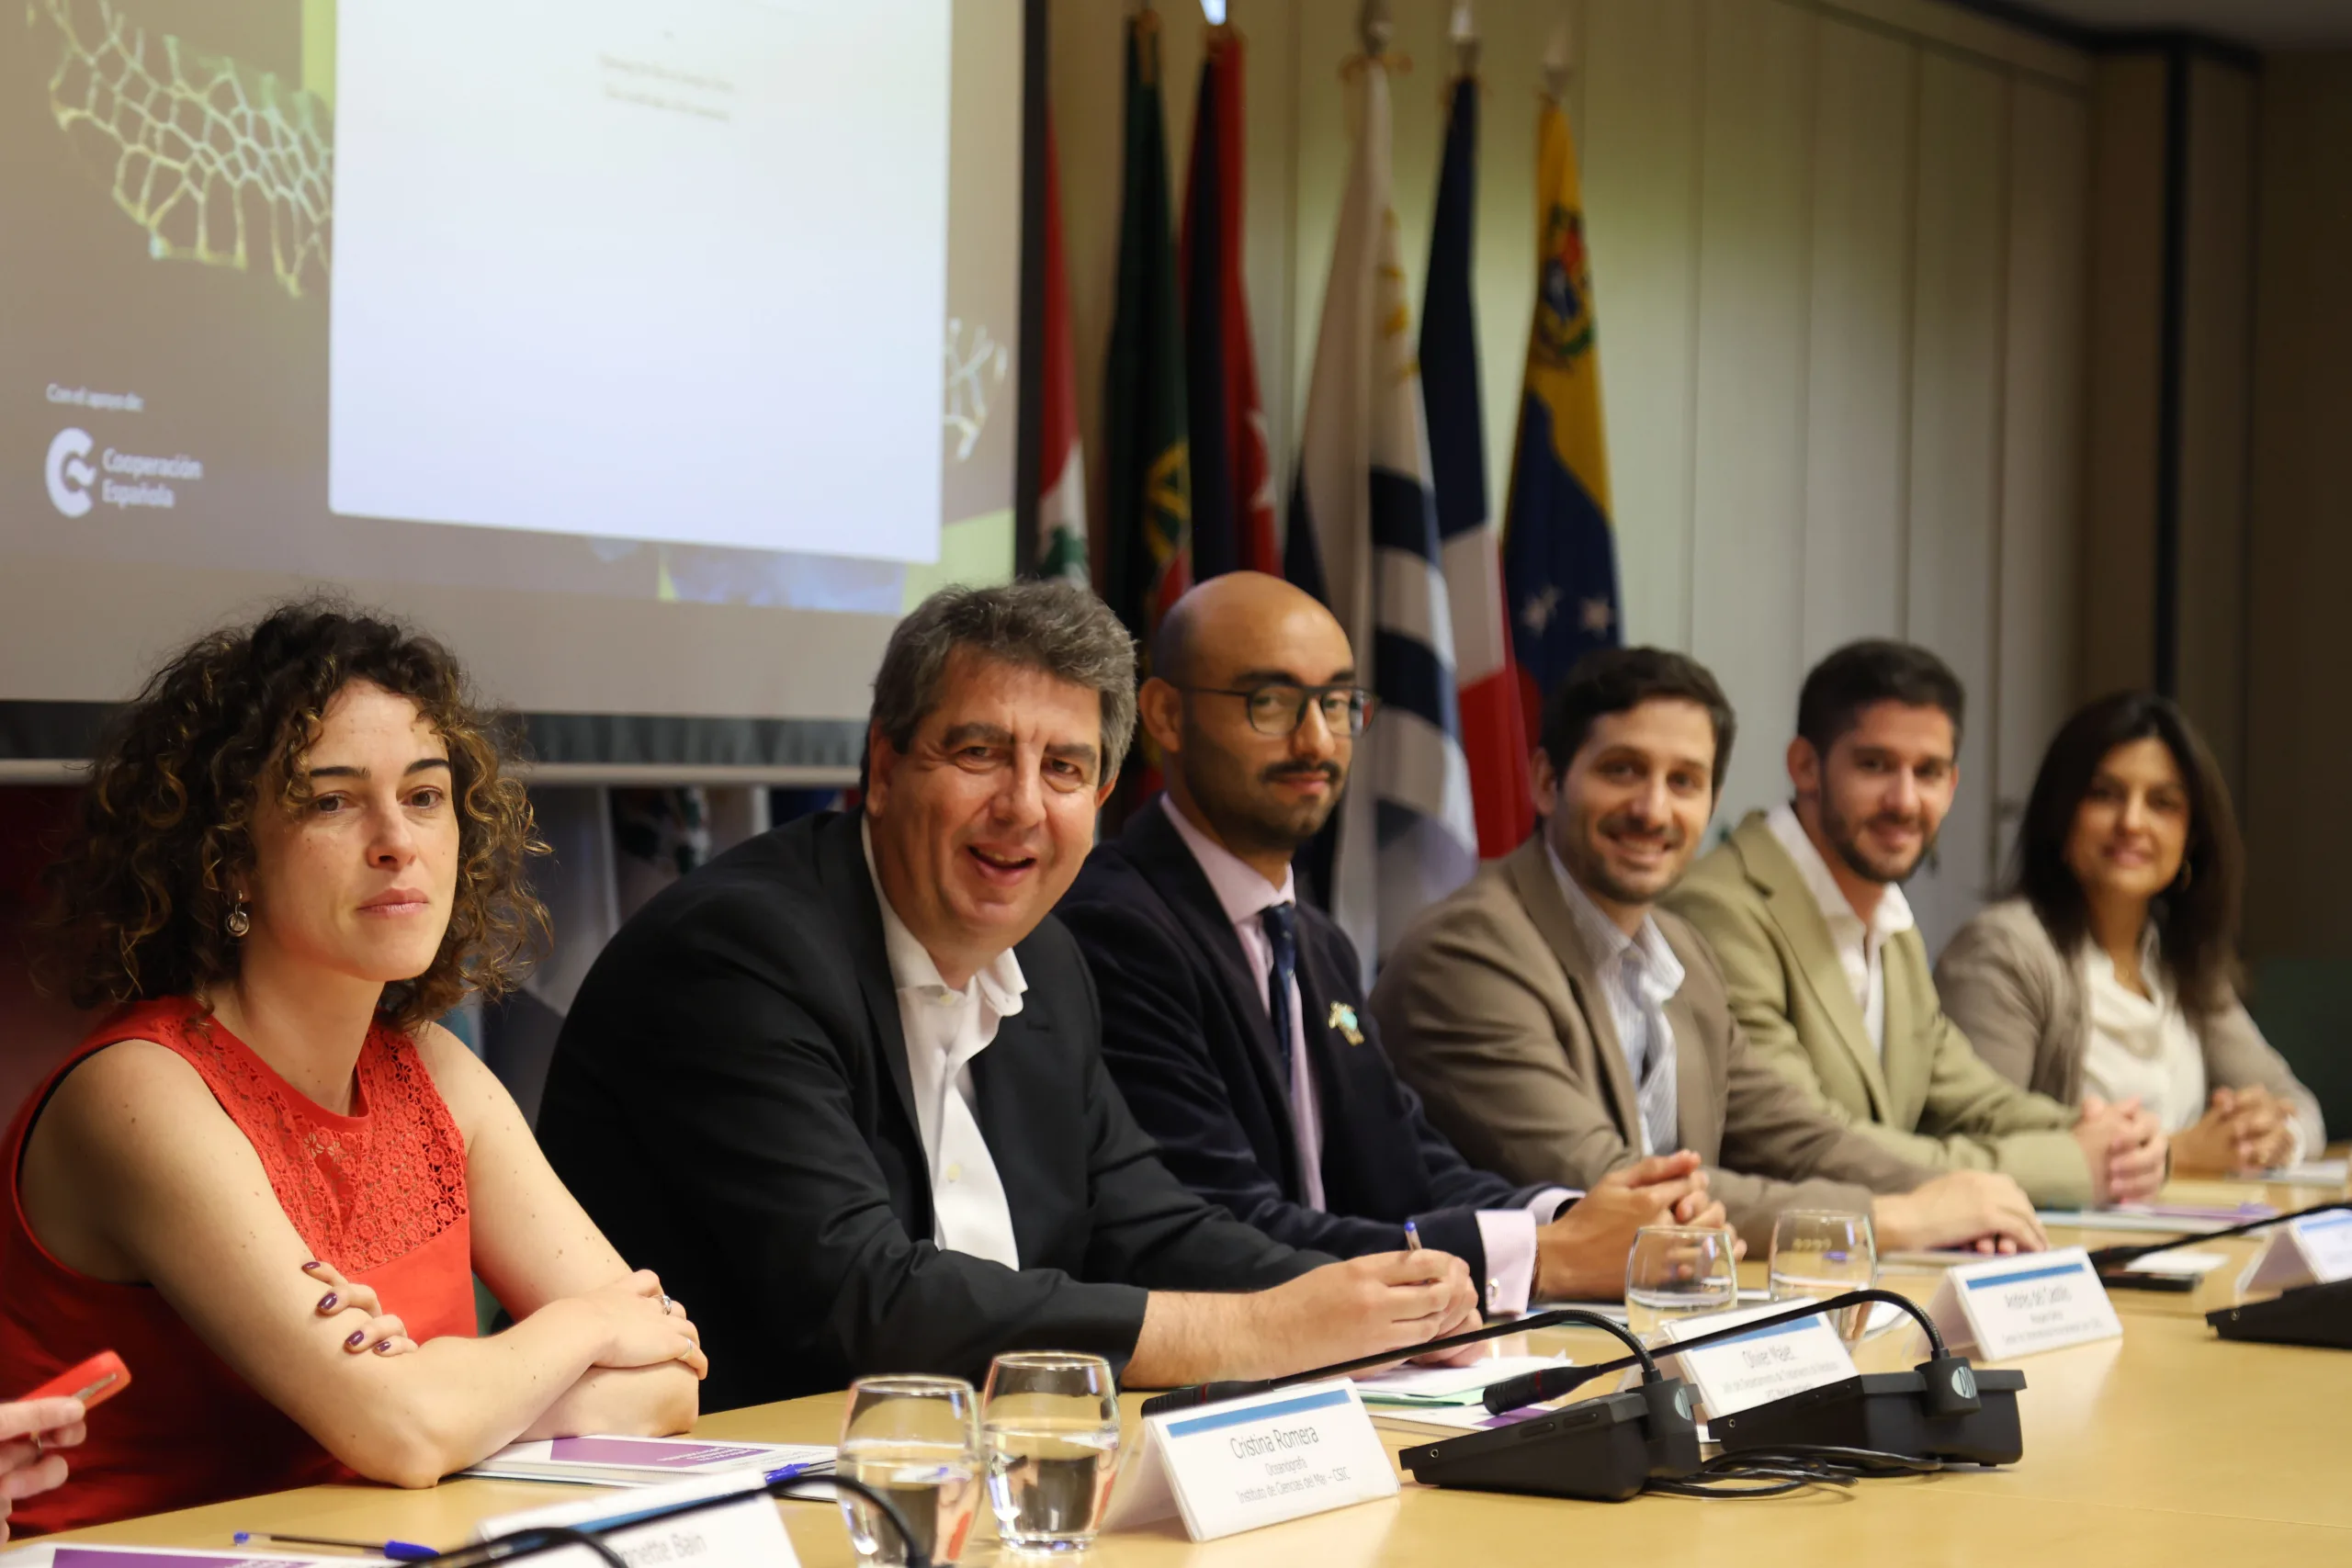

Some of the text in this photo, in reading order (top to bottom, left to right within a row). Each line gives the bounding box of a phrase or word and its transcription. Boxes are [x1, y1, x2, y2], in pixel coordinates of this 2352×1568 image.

[1229, 1426, 1319, 1460] Cristina Romera
[1267, 1485, 1278, 1497] de
[1275, 1478, 1305, 1495] Ciencias
[1303, 1475, 1315, 1490] del
[1332, 1466, 1351, 1483] CSIC
